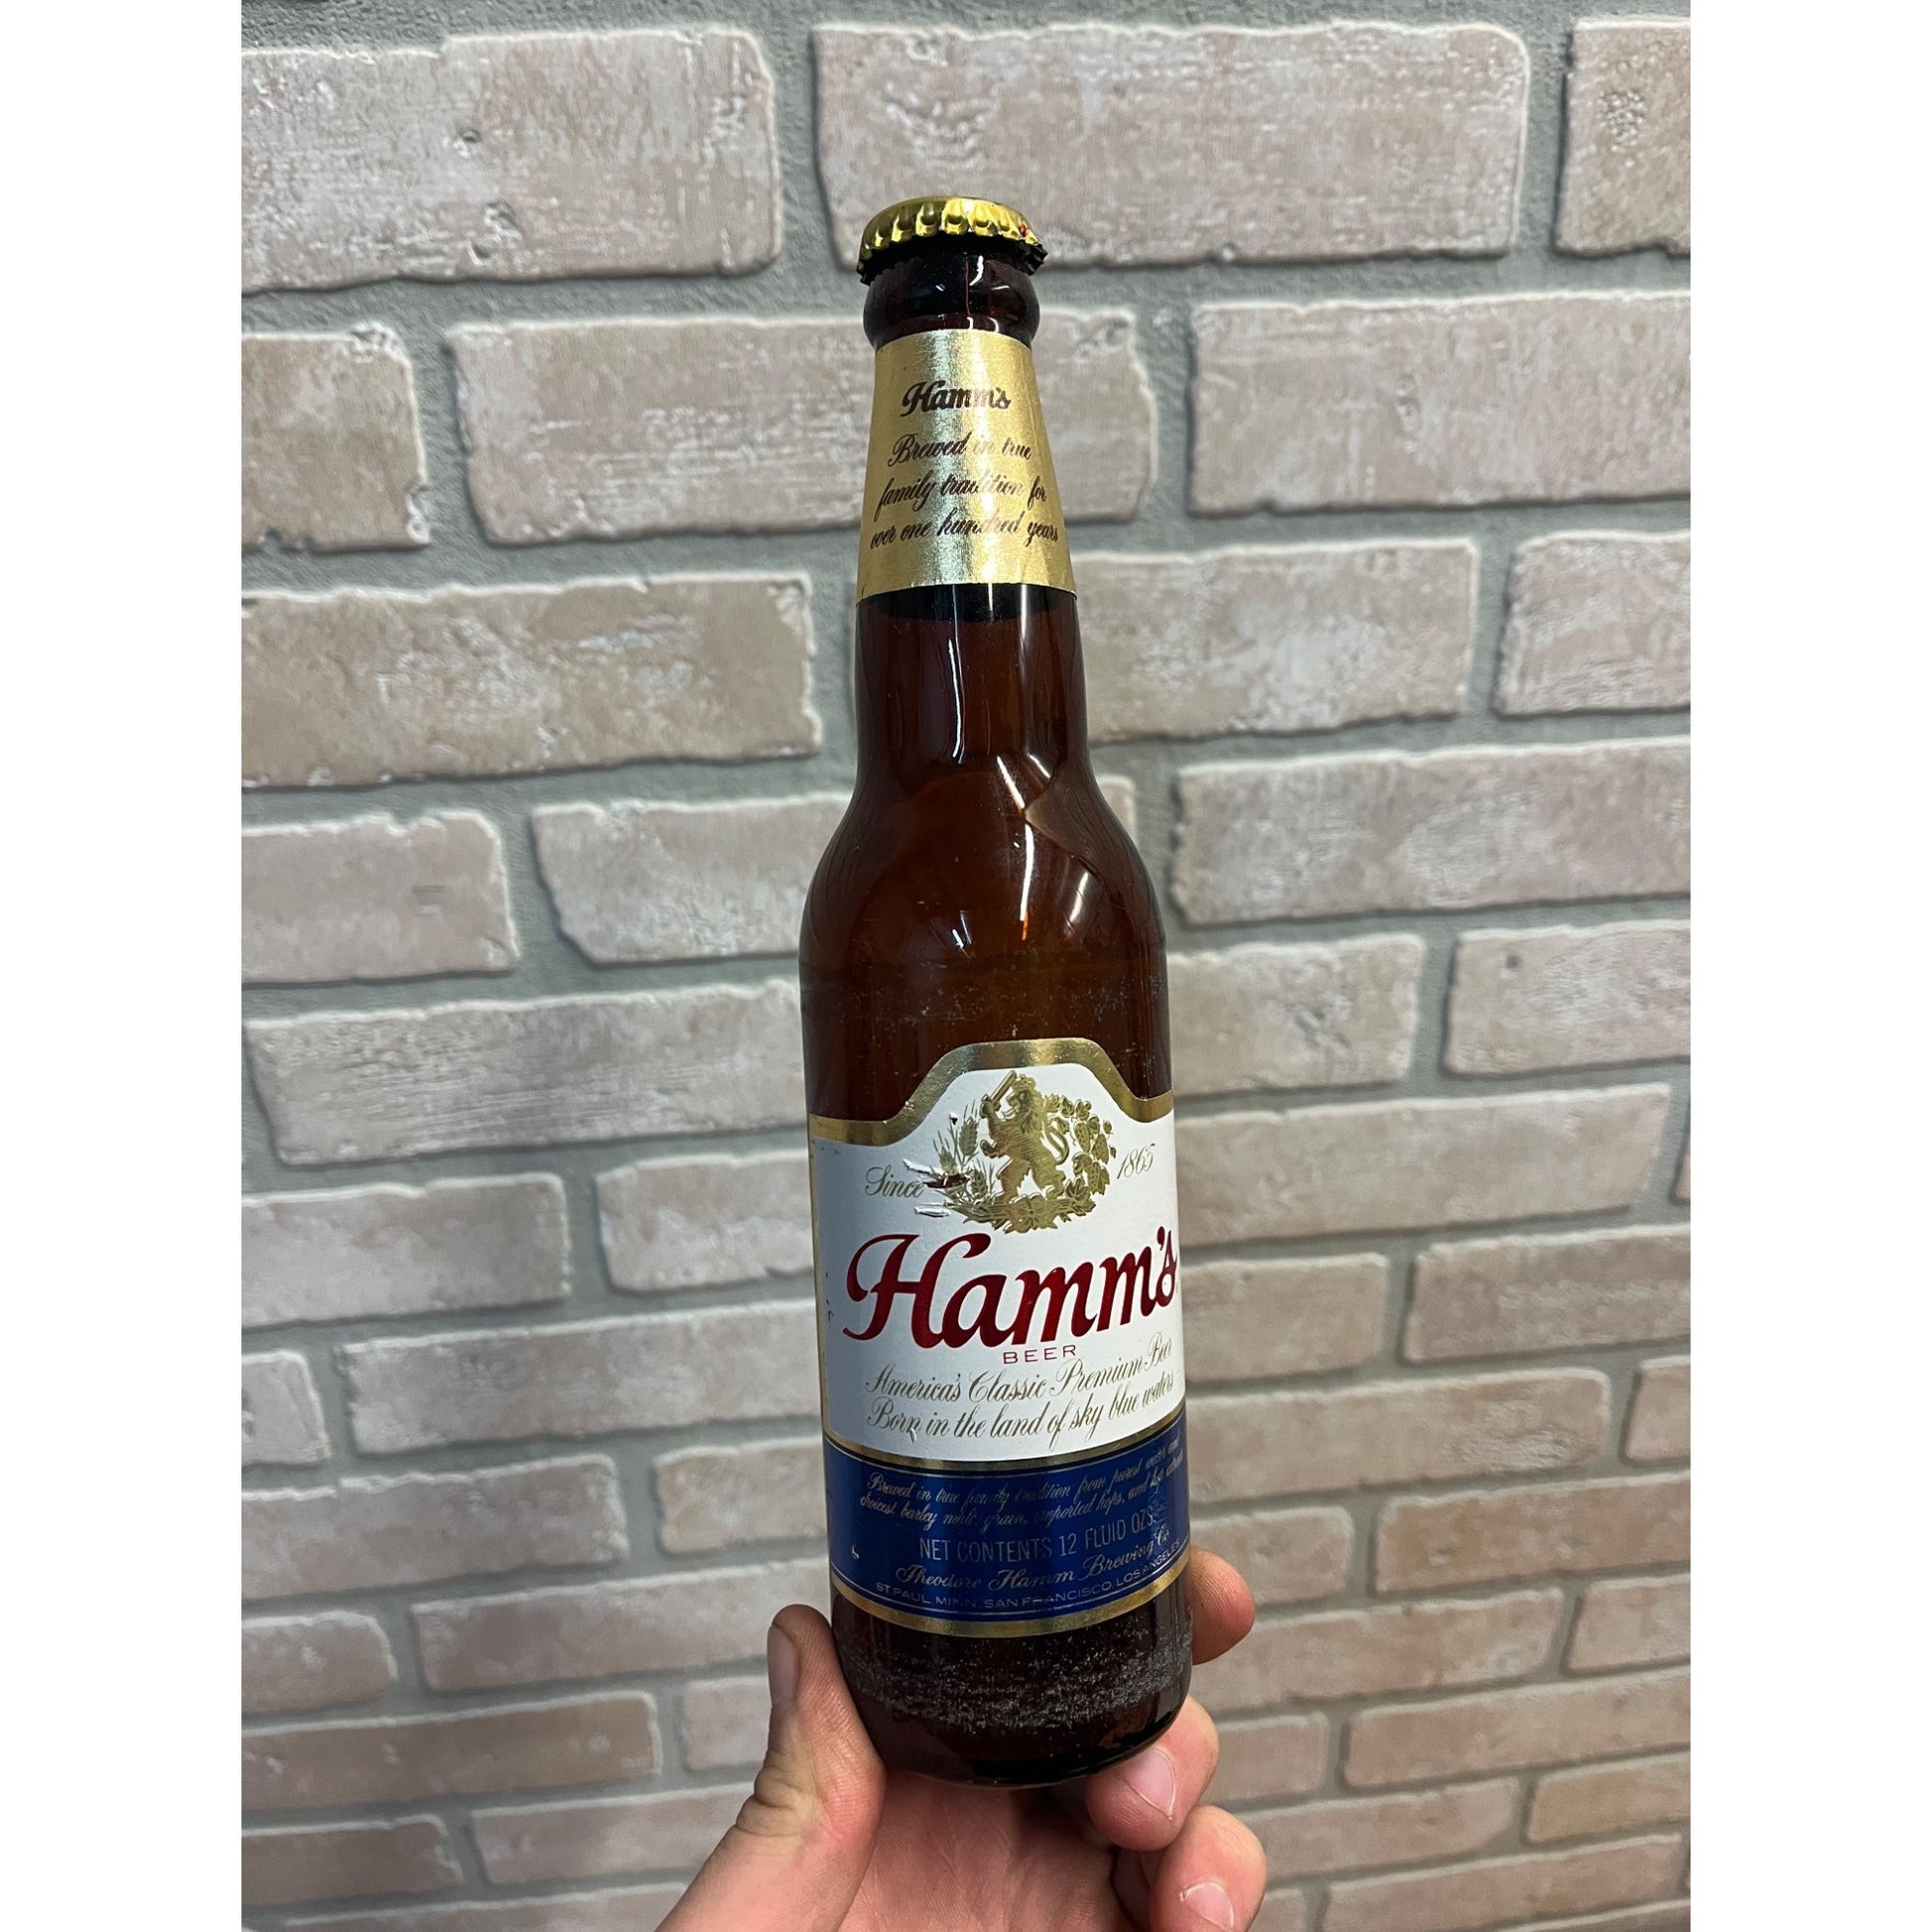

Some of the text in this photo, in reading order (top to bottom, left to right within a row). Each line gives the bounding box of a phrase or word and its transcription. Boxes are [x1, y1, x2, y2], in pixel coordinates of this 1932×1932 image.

[900, 380, 1012, 417] Hamm's
[888, 432, 1032, 467] Brewed in true
[875, 470, 1046, 522] family tradition for
[870, 507, 1058, 549] over one hundred years
[1116, 1143, 1156, 1180] 1865
[865, 1165, 924, 1198] Since
[842, 1226, 1177, 1348] Hamm's
[866, 1331, 1173, 1403] America's Classic Premium Beer
[1003, 1344, 1076, 1364] BEER
[866, 1370, 1174, 1451] Born in the land of sky blue waters
[867, 1471, 916, 1498] Brewed
[916, 1486, 931, 1501] in
[936, 1488, 960, 1502] true
[1073, 1476, 1107, 1504] from
[861, 1492, 896, 1515] choicest
[899, 1503, 938, 1531] barley
[919, 1538, 950, 1562] NET
[957, 1538, 1052, 1563] CONTENTS
[1059, 1533, 1077, 1557] 12
[1085, 1519, 1126, 1550] FLUID
[896, 1564, 982, 1588] Theodore
[988, 1569, 1075, 1590] Hamm
[1077, 1538, 1155, 1582] Brewing
[984, 1598, 1019, 1608] SAN
[1116, 1569, 1141, 1587] LOS
